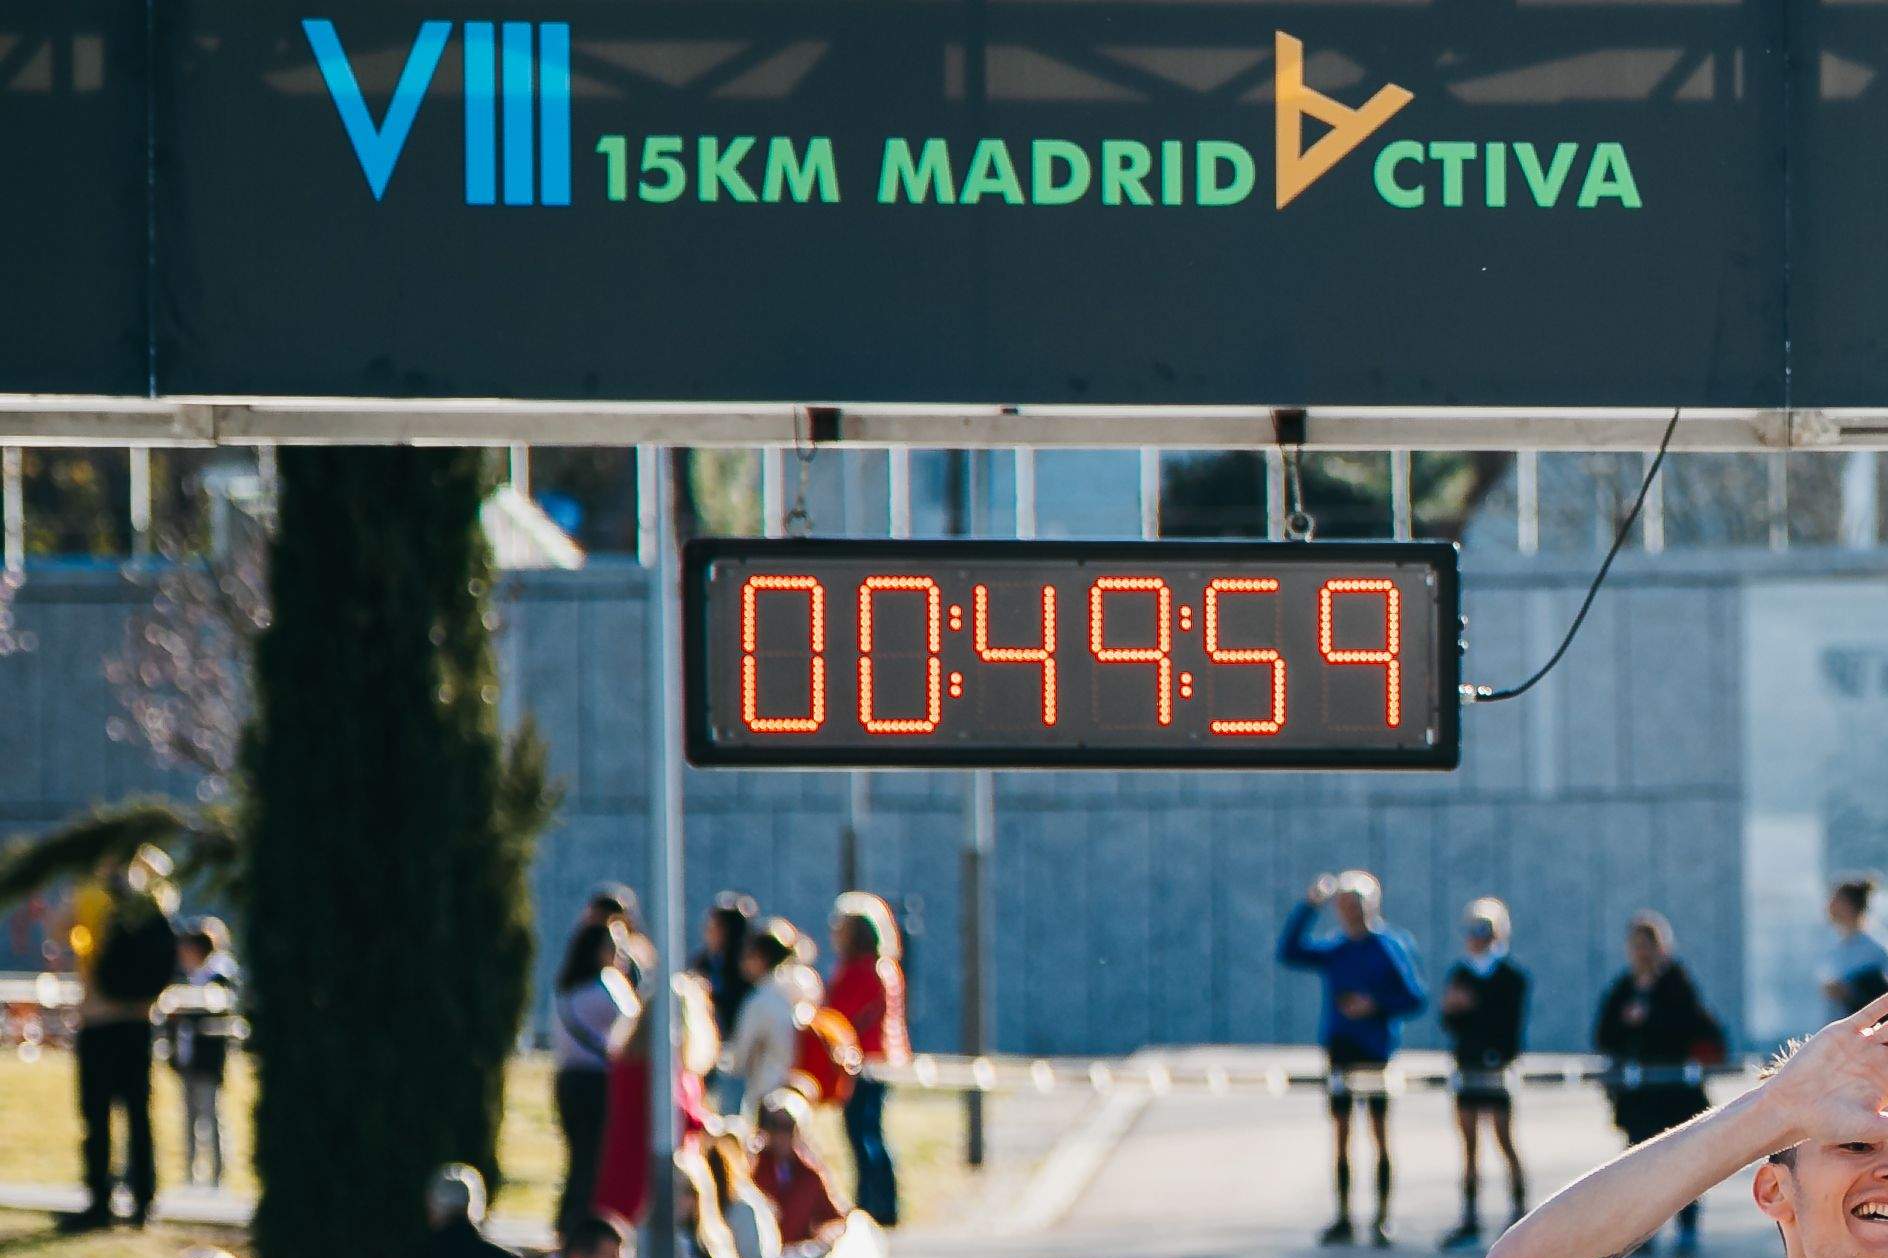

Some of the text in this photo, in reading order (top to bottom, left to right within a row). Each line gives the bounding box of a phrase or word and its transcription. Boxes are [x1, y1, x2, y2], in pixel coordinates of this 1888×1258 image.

[301, 19, 571, 205] VIII
[596, 135, 841, 205] 15KM
[876, 137, 1256, 207] MADRID
[740, 575, 1402, 734] 00:49:59
